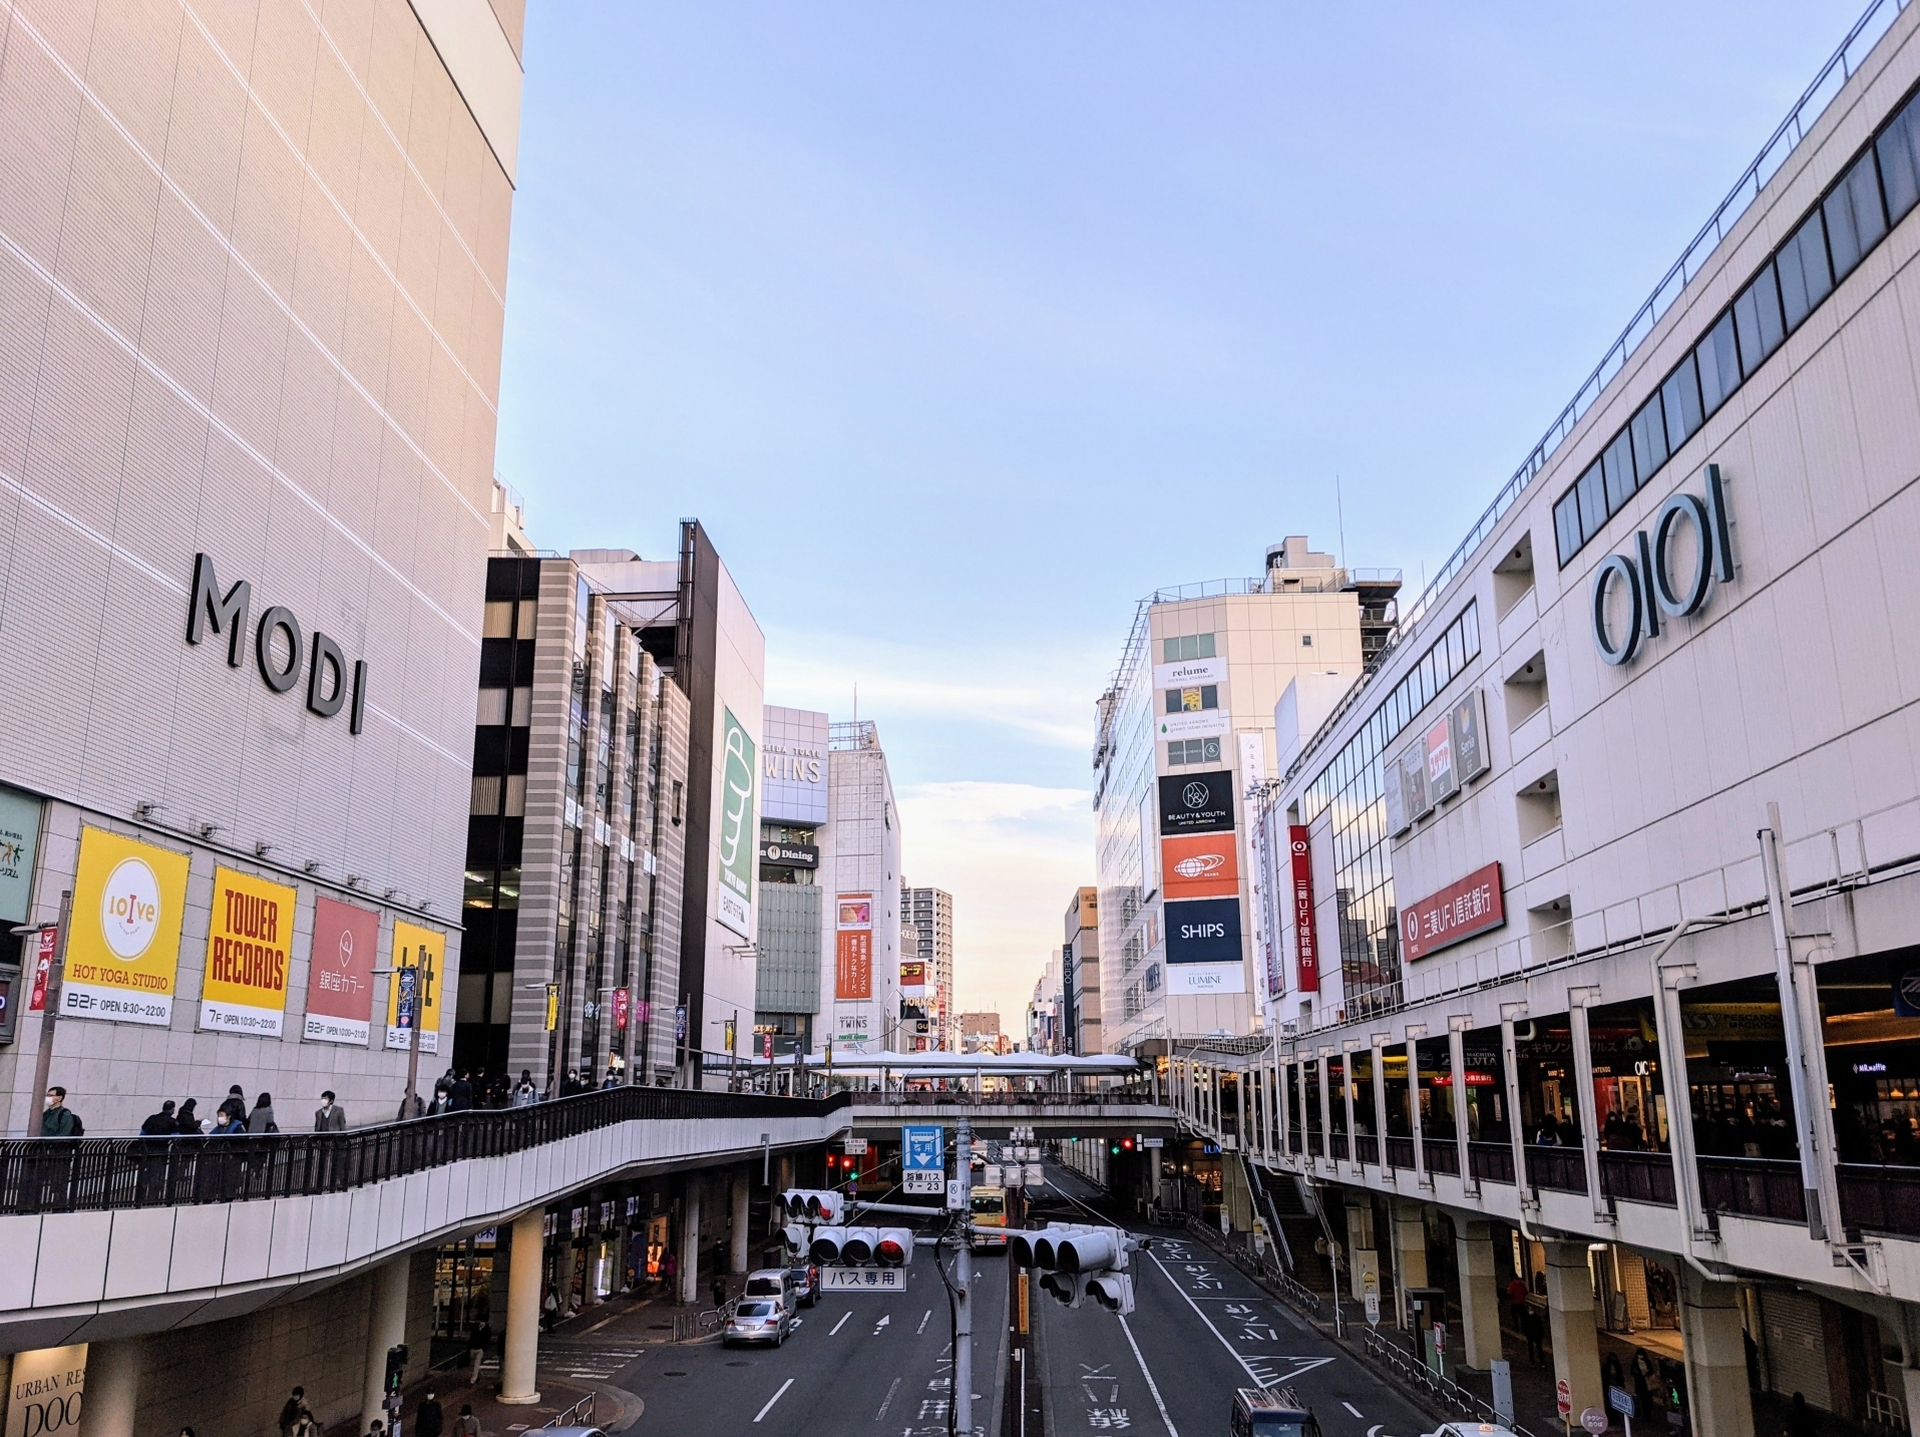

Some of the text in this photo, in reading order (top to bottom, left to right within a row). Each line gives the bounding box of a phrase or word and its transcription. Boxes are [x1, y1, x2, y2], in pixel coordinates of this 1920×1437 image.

[186, 552, 368, 735] MODI
[1172, 666, 1209, 677] relume
[1169, 725, 1186, 733] green
[1201, 722, 1225, 730] relaxing
[793, 748, 822, 758] TOKYU
[1461, 735, 1475, 756] Seria
[781, 848, 814, 863] Dining
[225, 888, 278, 943] TOWER
[1423, 883, 1491, 939] 三菱UFJ信託銀行
[1181, 923, 1225, 939] SHIPS
[1296, 879, 1313, 967] 三菱UFJ信託銀行
[212, 936, 284, 991] RECORDS
[1064, 950, 1072, 984] HOEIDO
[73, 963, 168, 991] HOT YOGA STUDIO
[319, 969, 365, 994] 銀座カラー
[1189, 975, 1222, 985] LUMINE
[67, 992, 98, 1009] B2F
[209, 1009, 222, 1024] 7F
[839, 1019, 868, 1029] TWINS
[307, 1021, 325, 1034] B2F
[914, 1143, 933, 1153] 専用
[907, 1172, 941, 1181] 路線バス
[830, 1271, 896, 1286] バス専用
[16, 1374, 60, 1400] URBAN
